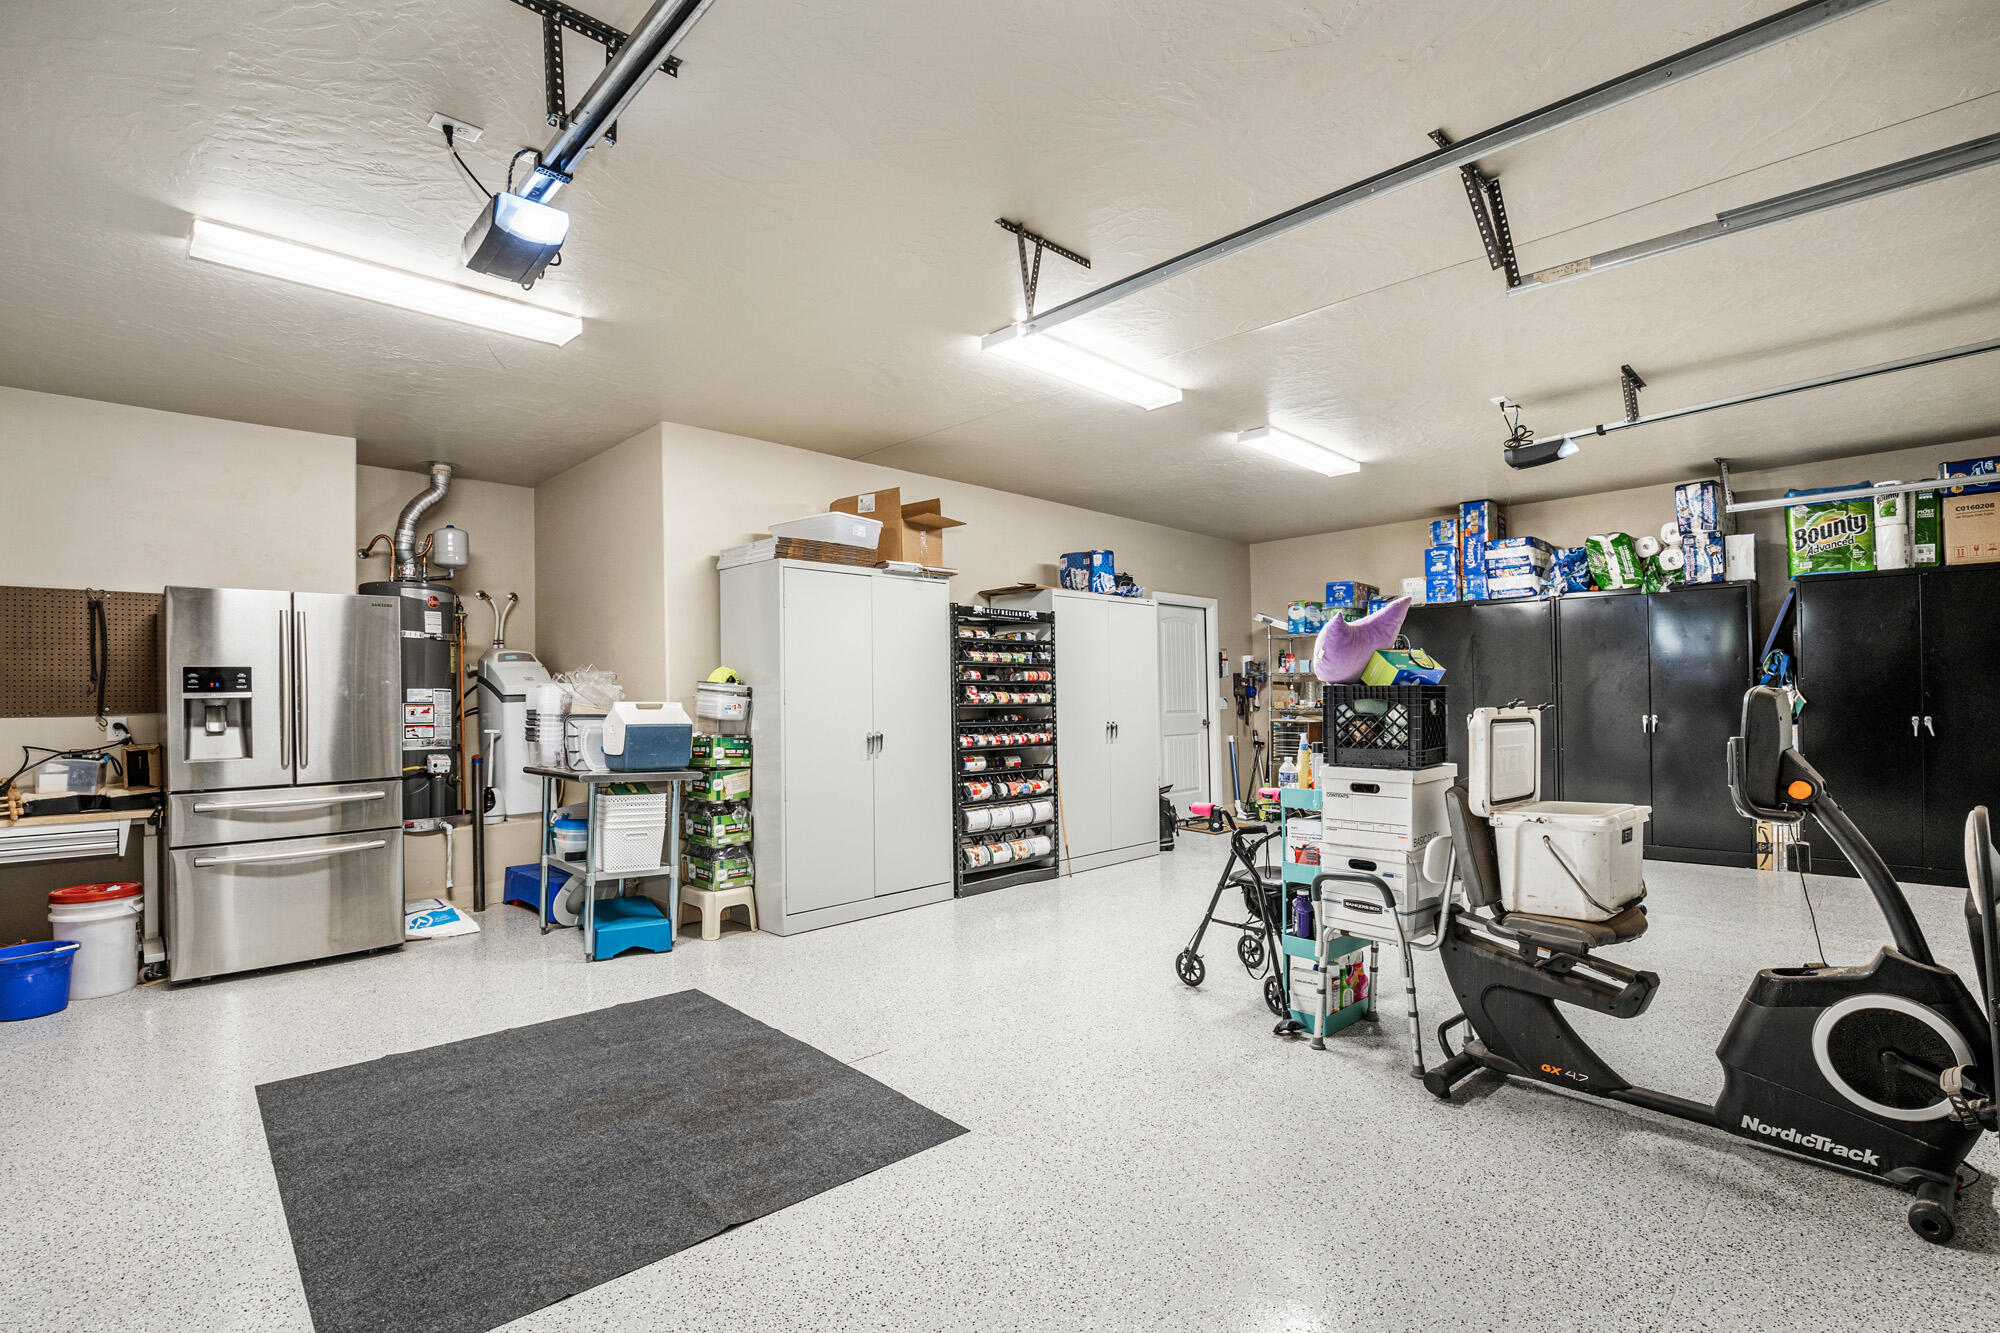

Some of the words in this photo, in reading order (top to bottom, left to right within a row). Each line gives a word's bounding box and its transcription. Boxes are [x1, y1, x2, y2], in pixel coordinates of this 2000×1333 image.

[1955, 502, 1995, 512] C0160208
[1793, 513, 1868, 551] Bounty
[1806, 536, 1855, 556] Advanced
[1541, 1063, 1562, 1076] GX
[1740, 1114, 1881, 1167] NordicTrack
